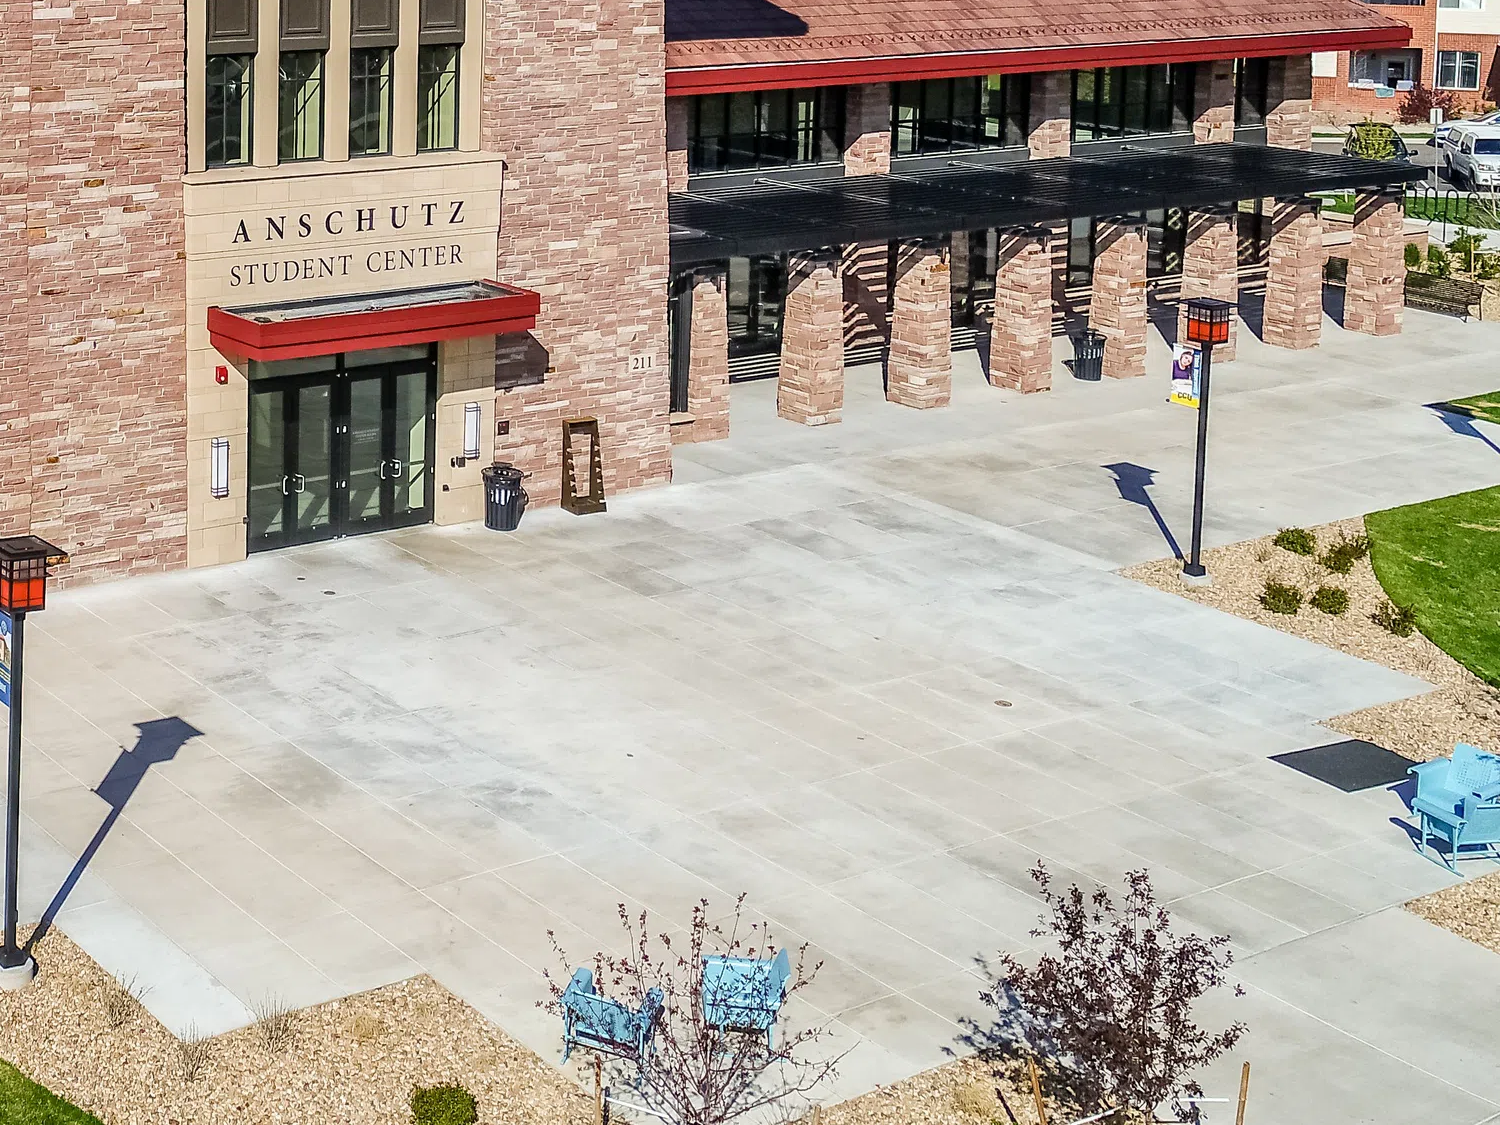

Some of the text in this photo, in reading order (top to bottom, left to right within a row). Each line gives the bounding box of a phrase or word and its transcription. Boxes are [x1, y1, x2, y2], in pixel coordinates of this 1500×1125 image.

[232, 201, 466, 244] ANSCHUTZ
[230, 244, 464, 287] STUDENT CENTER
[633, 356, 652, 370] 211
[1177, 391, 1193, 402] CCU
